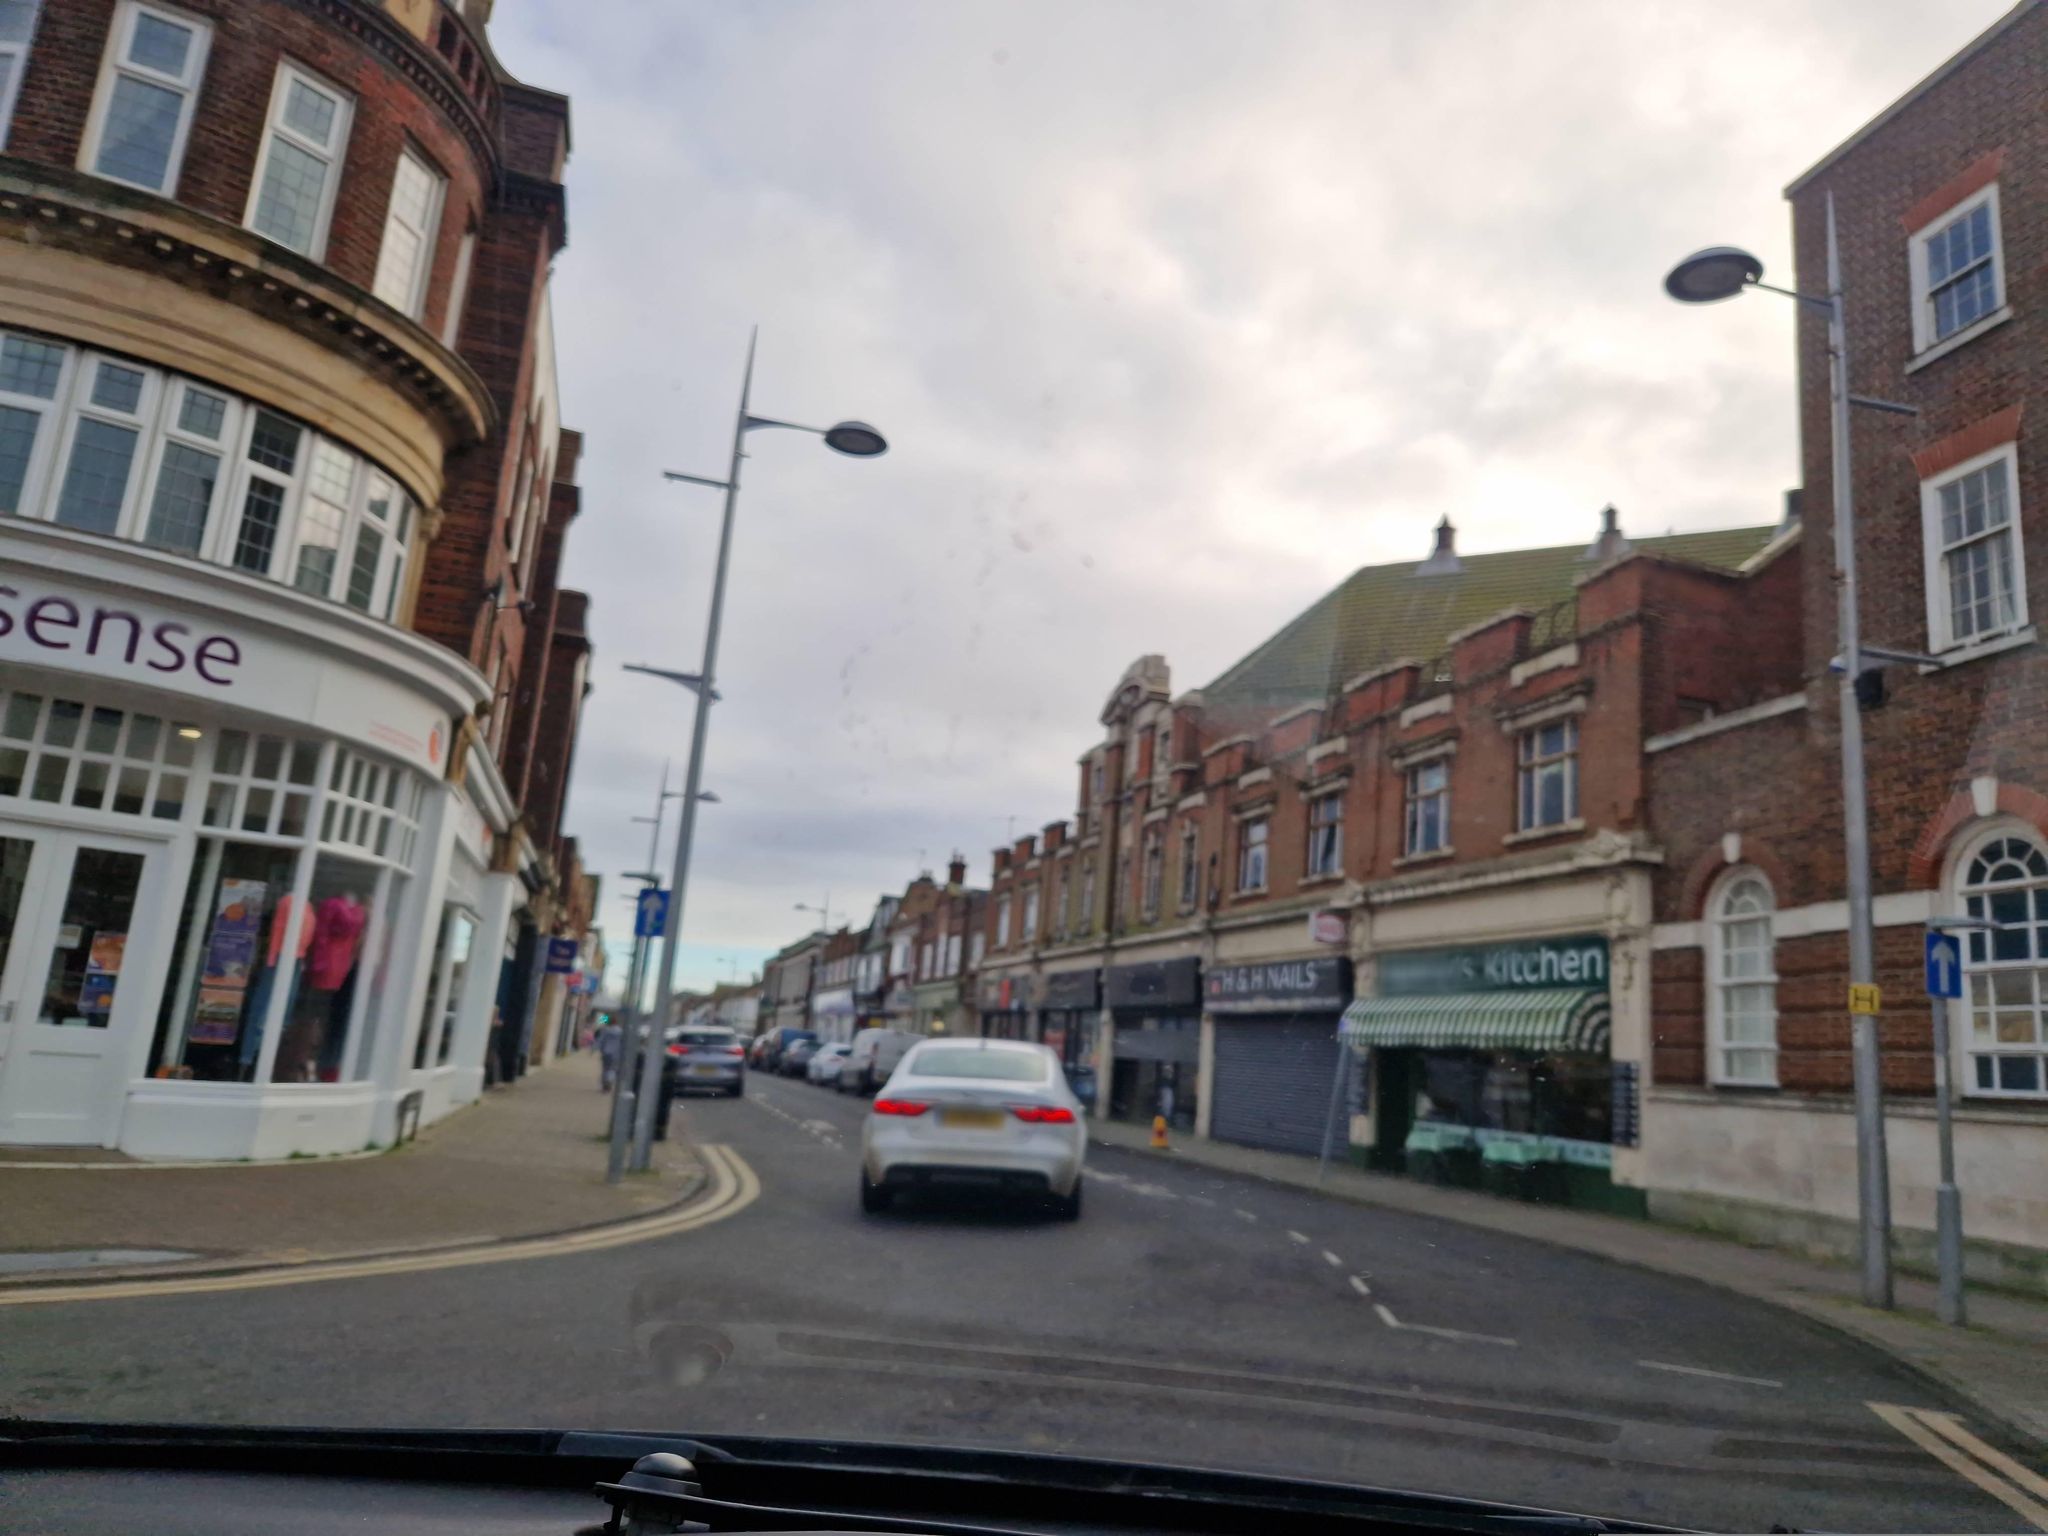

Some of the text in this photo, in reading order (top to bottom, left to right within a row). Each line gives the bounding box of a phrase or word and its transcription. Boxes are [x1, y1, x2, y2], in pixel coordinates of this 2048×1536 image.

[1222, 960, 1318, 992] H & H NAILS
[1853, 987, 1875, 1009] H
